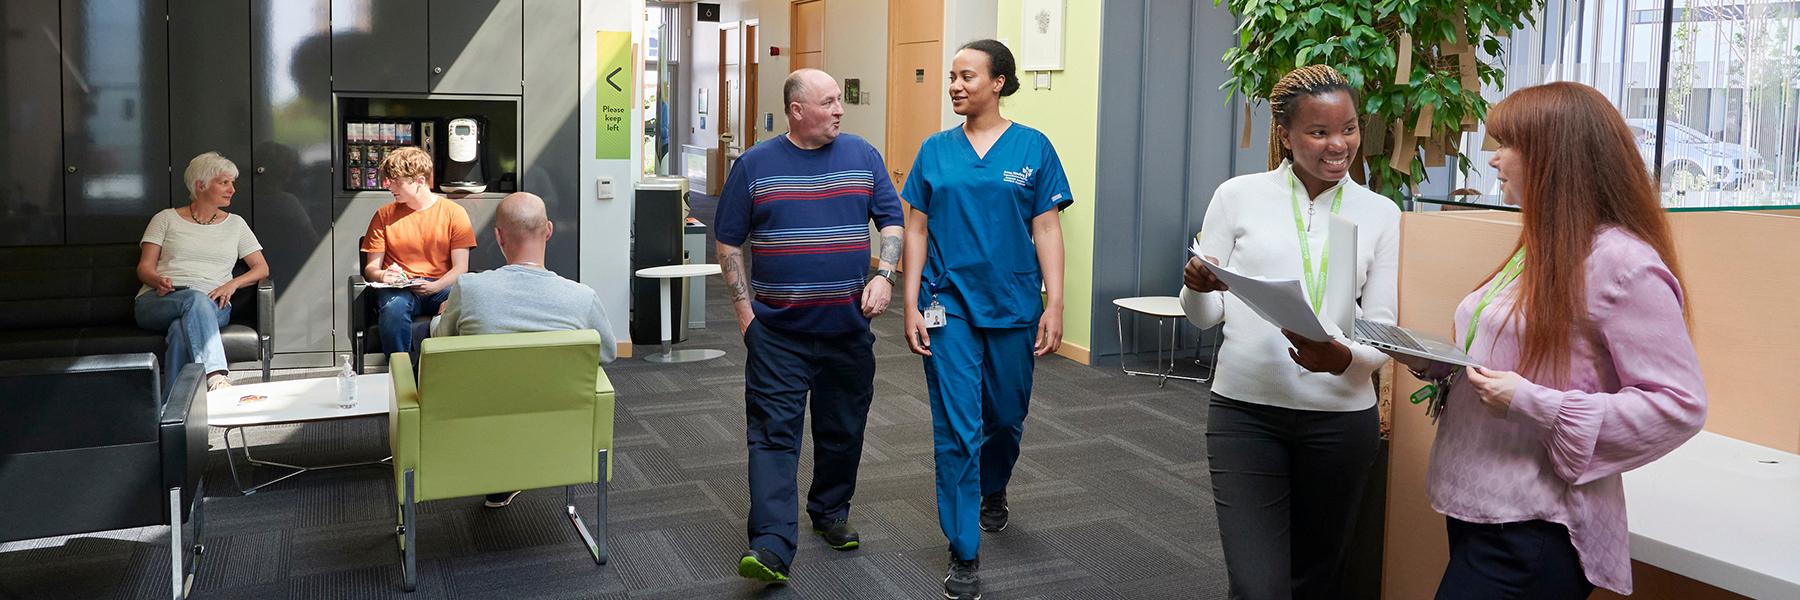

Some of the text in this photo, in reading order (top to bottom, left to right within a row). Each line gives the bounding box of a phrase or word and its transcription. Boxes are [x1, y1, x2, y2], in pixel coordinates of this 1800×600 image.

[706, 8, 712, 18] 6
[602, 105, 625, 113] Please
[604, 114, 621, 124] keep
[606, 124, 620, 132] left
